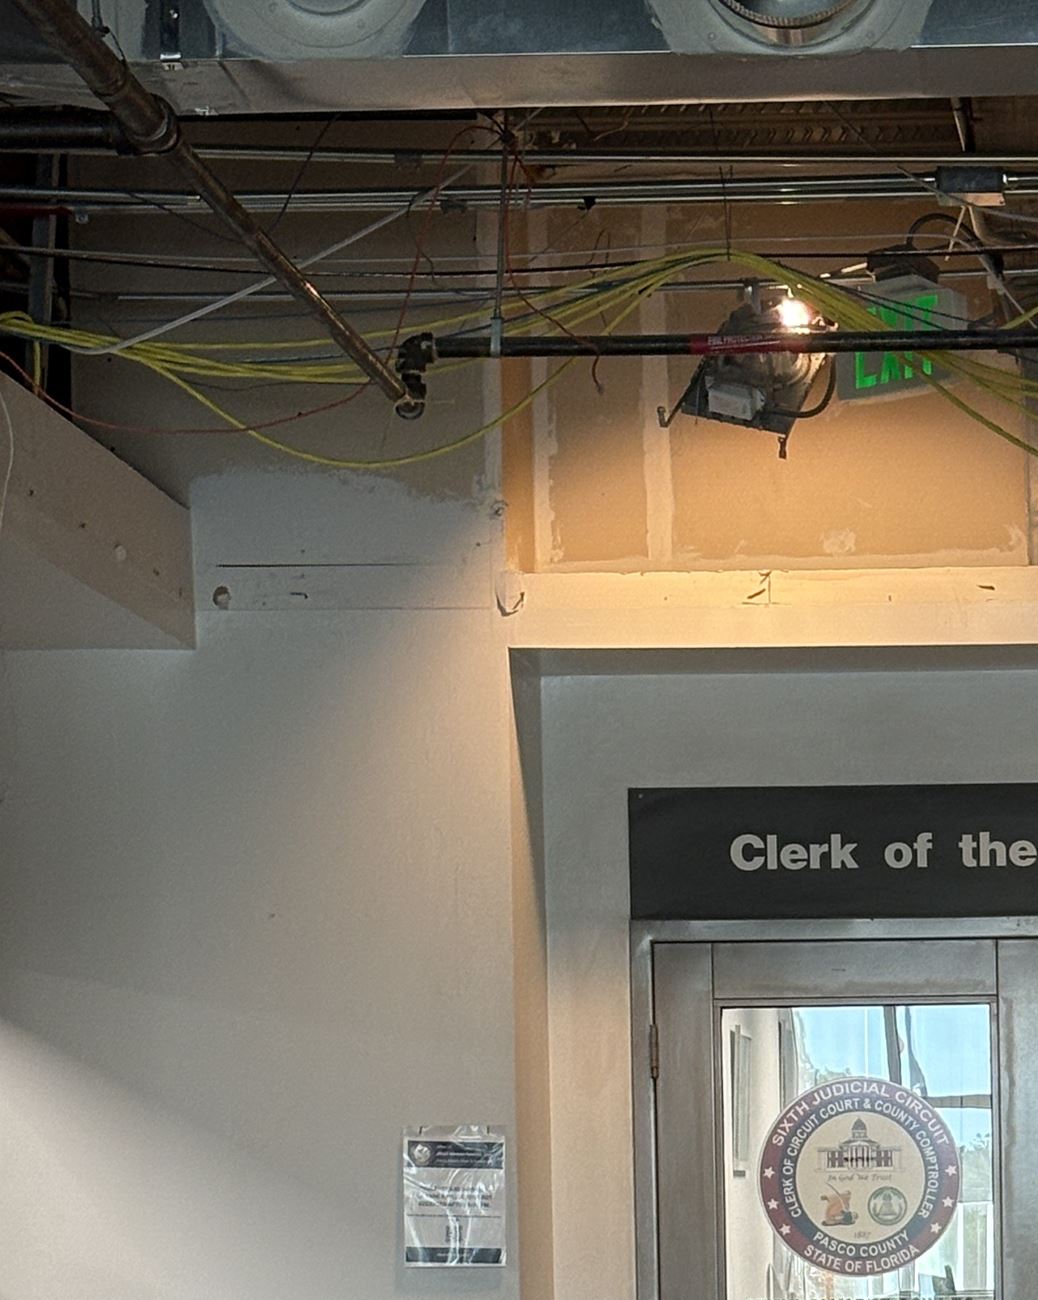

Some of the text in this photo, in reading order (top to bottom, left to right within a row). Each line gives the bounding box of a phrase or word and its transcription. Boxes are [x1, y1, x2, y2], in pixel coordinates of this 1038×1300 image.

[730, 833, 859, 871] Clerk
[884, 832, 933, 869] of
[958, 831, 1038, 868] the
[772, 1080, 949, 1146] SIXTH JUDICIAL CIRCUIT
[781, 1098, 939, 1218] CLERK OF CIRCUIT COURT & COUNTY COMPTROLLER
[804, 1244, 920, 1273] STATE OF FLORIDA
[814, 1230, 910, 1257] PASCO COUNTY
